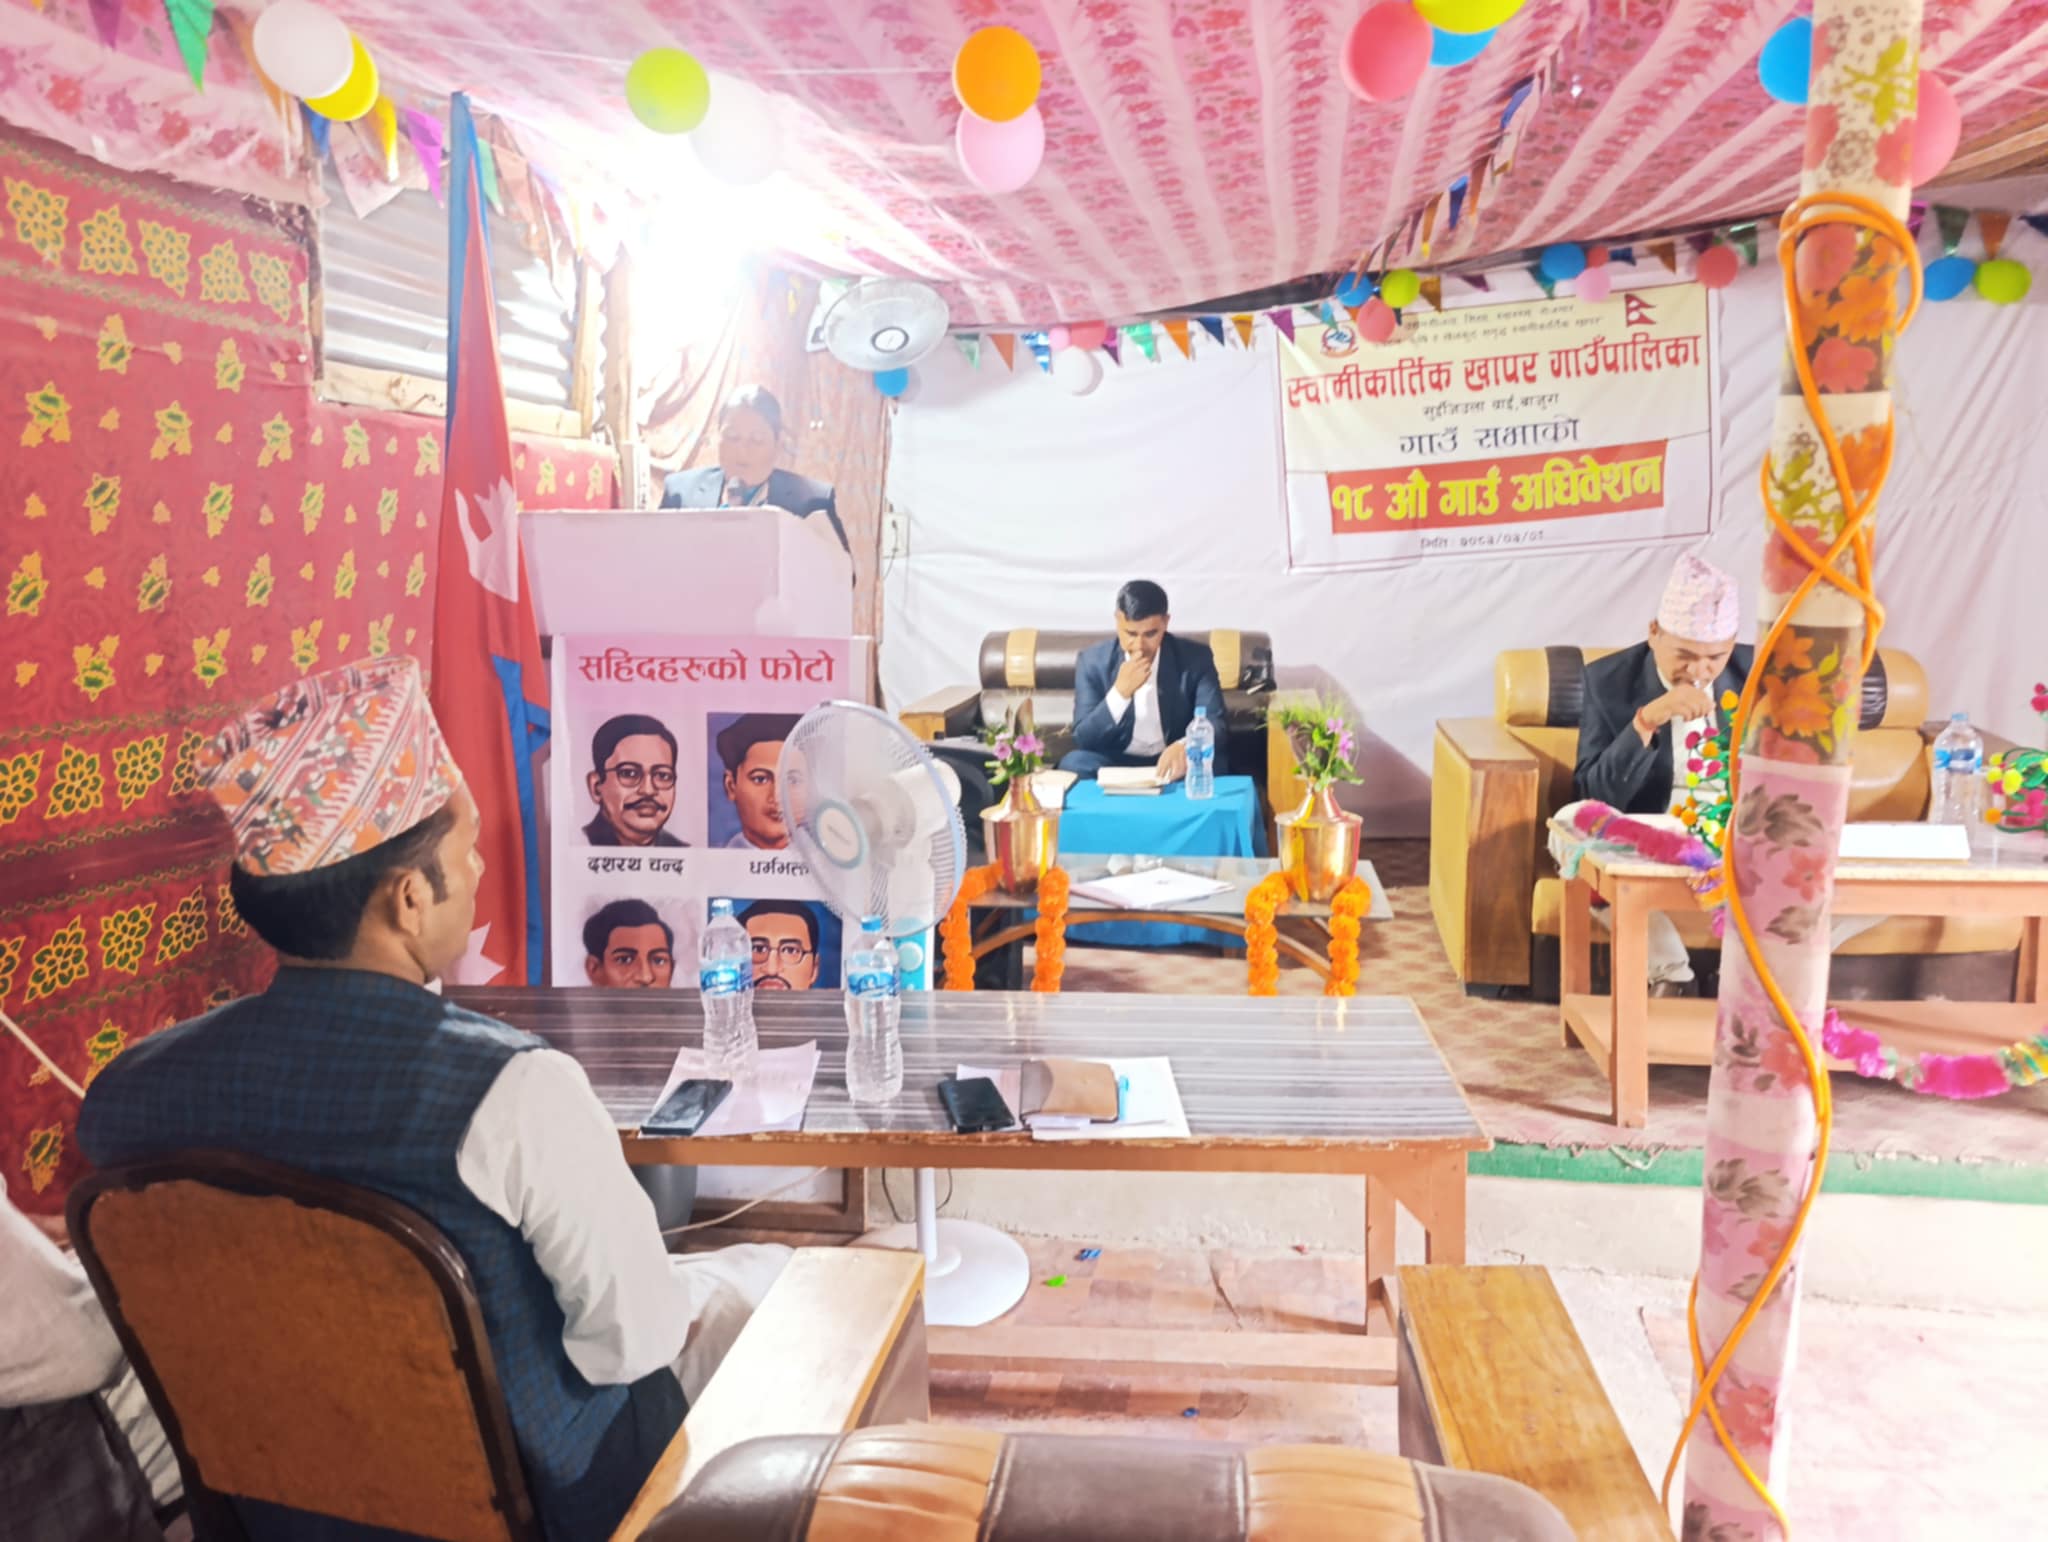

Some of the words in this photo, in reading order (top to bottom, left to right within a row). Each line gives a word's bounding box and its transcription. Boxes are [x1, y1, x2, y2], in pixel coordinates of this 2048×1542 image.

[1463, 352, 1538, 391] खापर
[1549, 332, 1701, 378] गाउँपालिका
[1400, 426, 1458, 455] गाउँ
[1474, 414, 1579, 449] सभाको
[1331, 484, 1373, 521] १८
[1511, 454, 1663, 512] अधिवेशन
[760, 649, 834, 682] फोटो
[587, 856, 642, 873] दशरथ
[648, 857, 685, 876] चन्द
